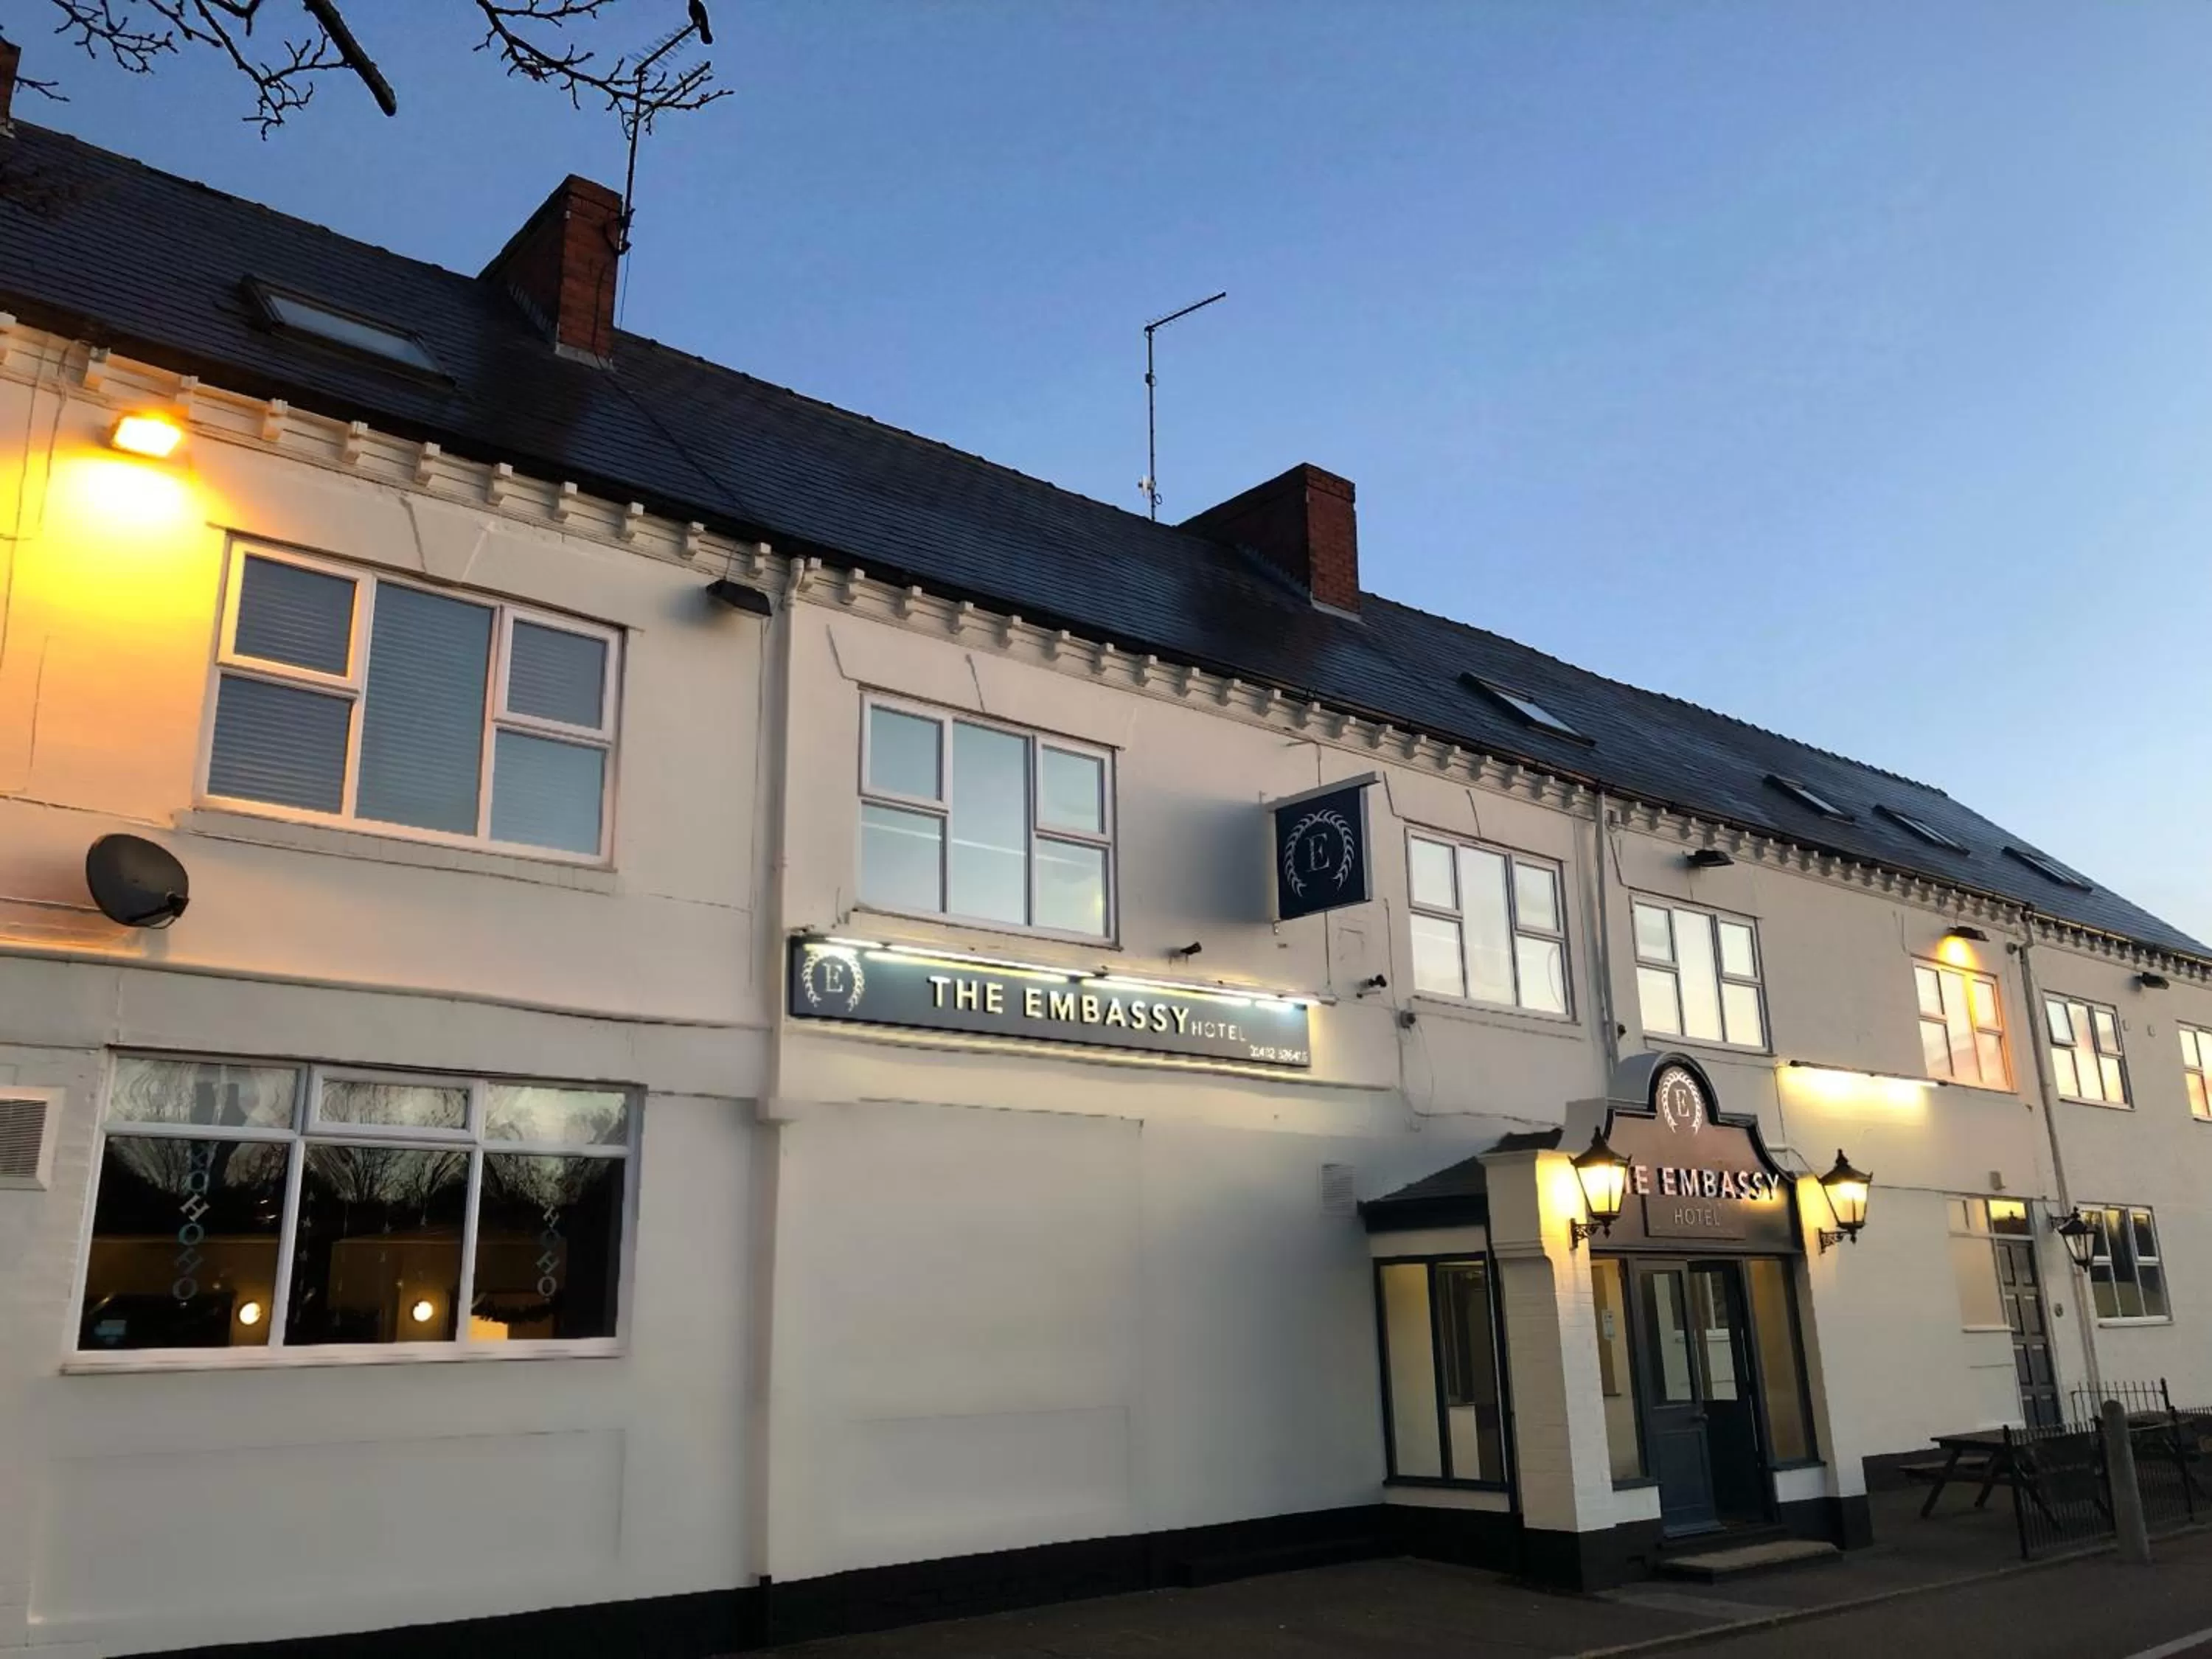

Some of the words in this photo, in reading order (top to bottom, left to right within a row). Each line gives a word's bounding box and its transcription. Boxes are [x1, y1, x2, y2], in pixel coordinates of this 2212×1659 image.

[1305, 833, 1329, 873] E
[824, 962, 844, 992] E
[928, 975, 1003, 1015] THE
[1023, 987, 1189, 1034] EMBASSY
[1192, 1020, 1248, 1042] HOTEL
[1674, 1089, 1690, 1118] E
[1661, 1166, 1779, 1200] EMBASSY
[1674, 1208, 1720, 1226] HOTEL
